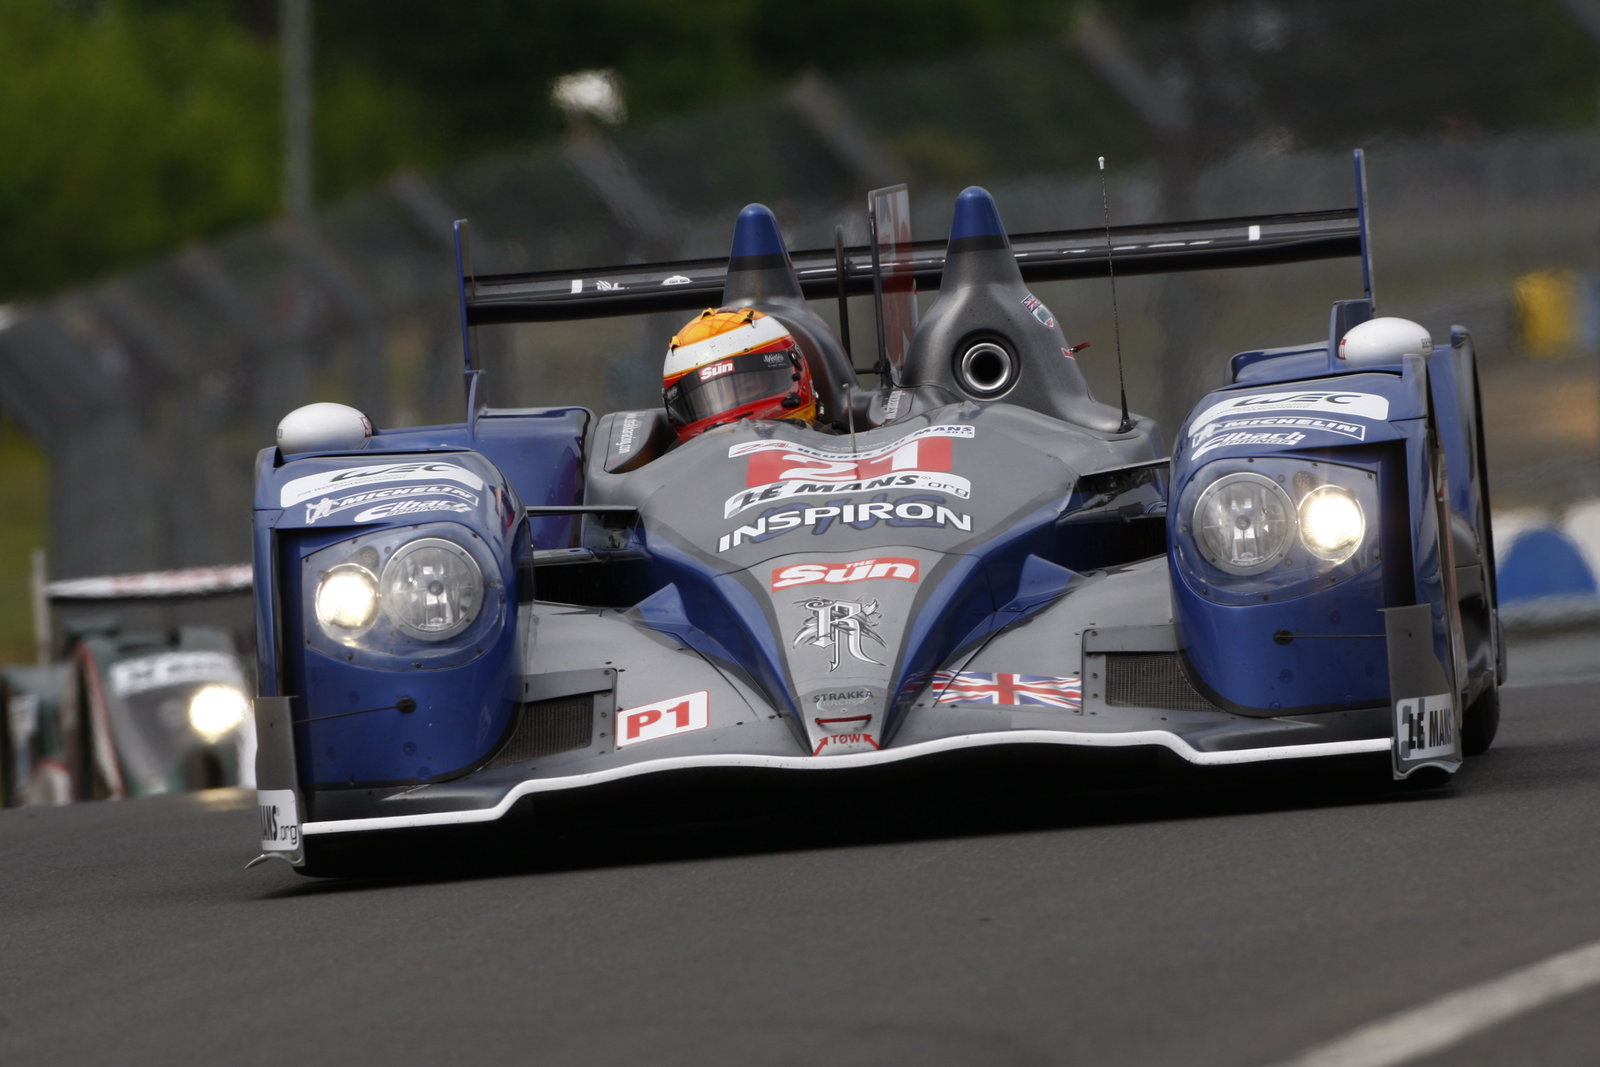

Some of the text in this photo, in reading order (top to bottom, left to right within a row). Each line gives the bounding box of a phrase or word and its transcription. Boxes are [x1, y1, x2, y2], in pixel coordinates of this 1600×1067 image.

[700, 363, 734, 380] Sun
[1232, 394, 1362, 407] WEC
[911, 426, 973, 437] MANS
[1223, 417, 1358, 433] MICHELIN
[1191, 431, 1307, 461] Eibach
[779, 440, 918, 481] 21
[331, 463, 461, 482] WEC
[340, 486, 473, 507] MICHELIN
[739, 481, 787, 510] LE
[793, 475, 920, 494] MANS
[719, 502, 972, 553] INSPIRON
[846, 559, 876, 569] THE
[773, 562, 916, 588] Sun
[813, 691, 874, 703] STRAKKA
[627, 701, 690, 740] P1
[1408, 708, 1453, 750] LE MAN
[831, 733, 861, 745] TOW
[258, 805, 278, 841] ANS
